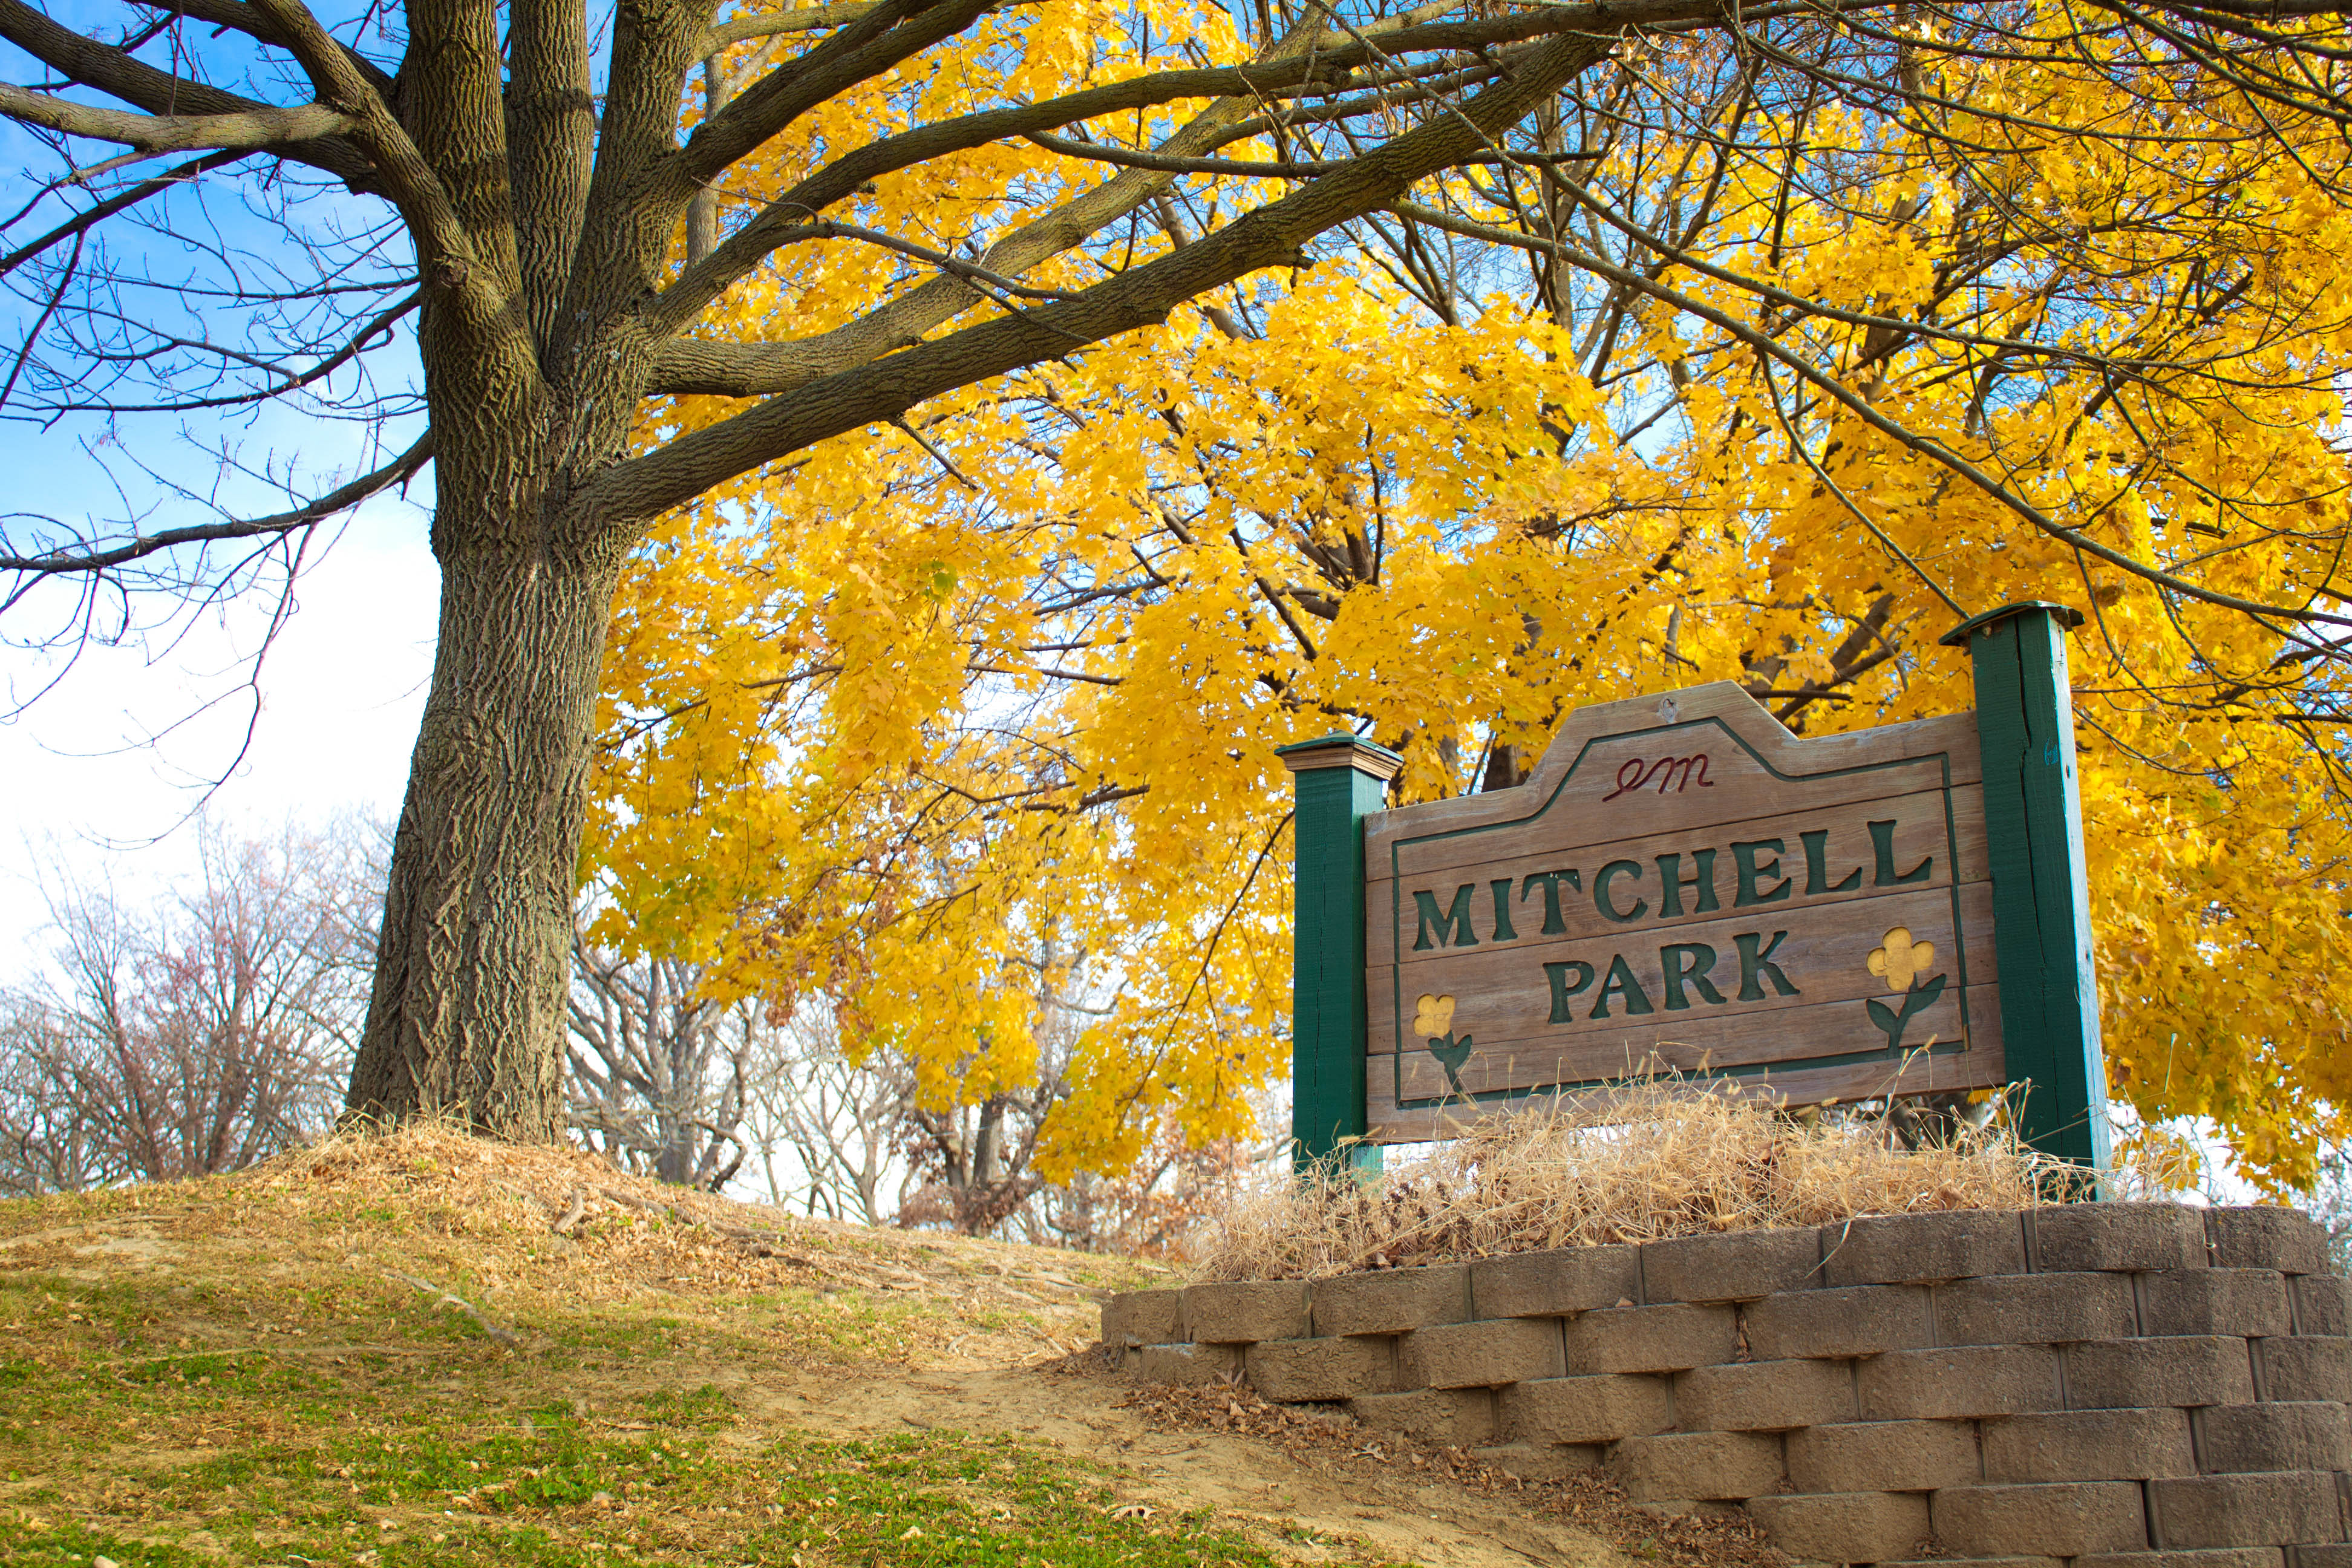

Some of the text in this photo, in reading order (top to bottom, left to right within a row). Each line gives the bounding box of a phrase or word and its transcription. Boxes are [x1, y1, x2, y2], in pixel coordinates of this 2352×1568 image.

[1602, 754, 1714, 802] em
[1412, 819, 1933, 951] MITCHELL
[1542, 930, 1800, 1025] PARK
